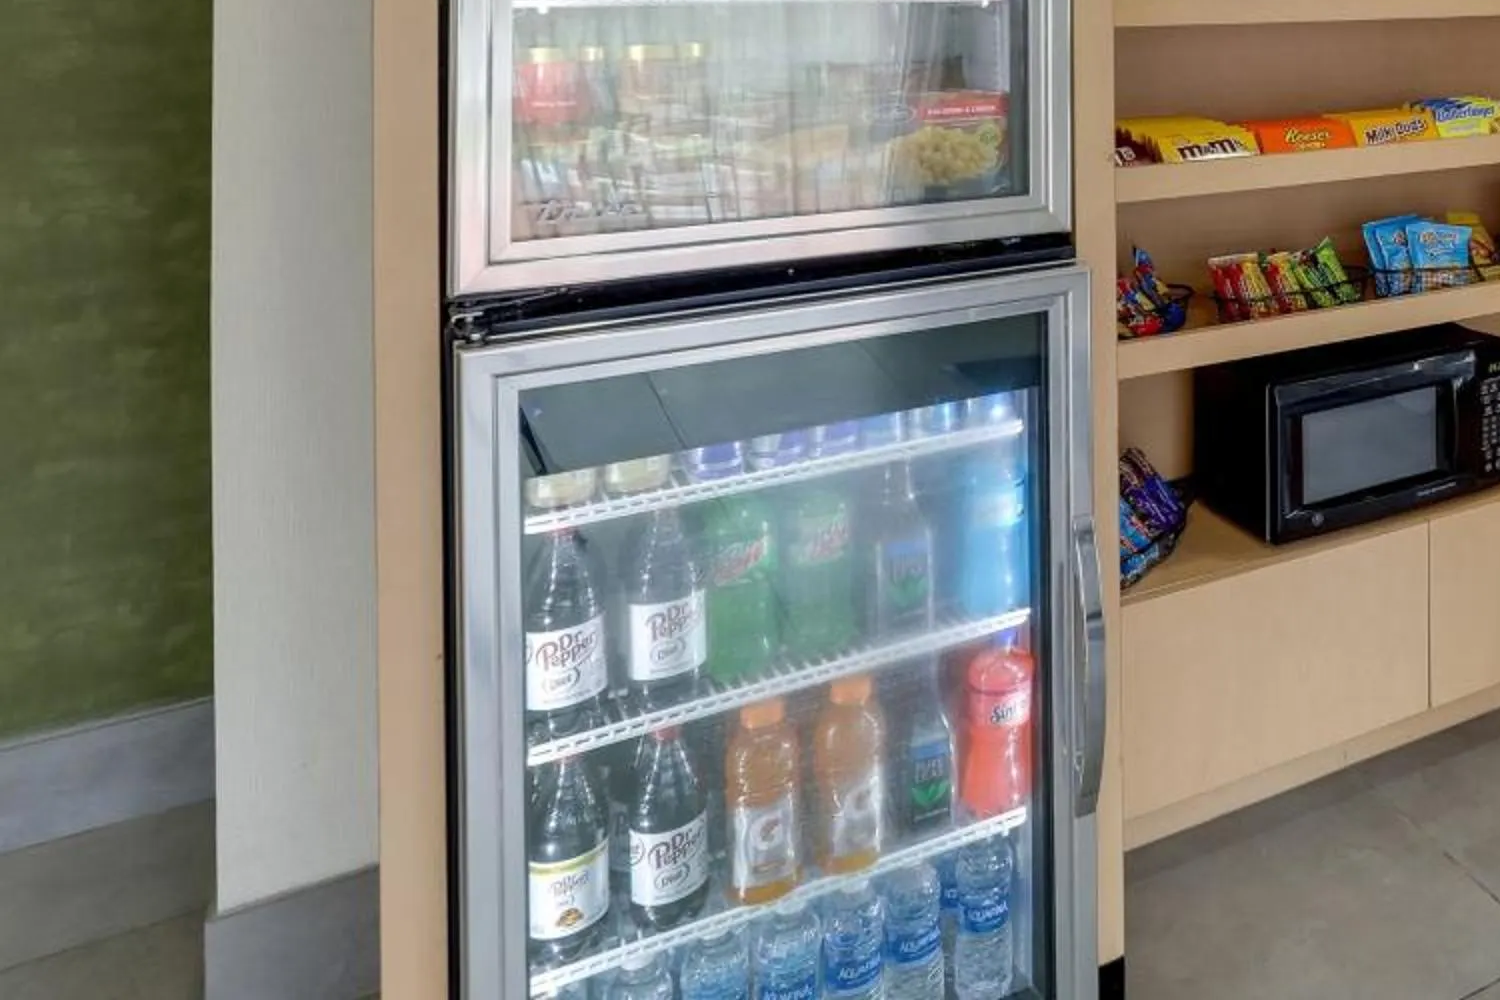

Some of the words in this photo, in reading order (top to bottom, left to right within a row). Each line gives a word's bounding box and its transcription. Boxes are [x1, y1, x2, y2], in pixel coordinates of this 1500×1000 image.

[1436, 105, 1495, 122] Butterfinger
[535, 631, 598, 671] Pepper
[557, 630, 583, 652] Dr
[647, 826, 705, 870] Pepper
[671, 828, 692, 850] Dr
